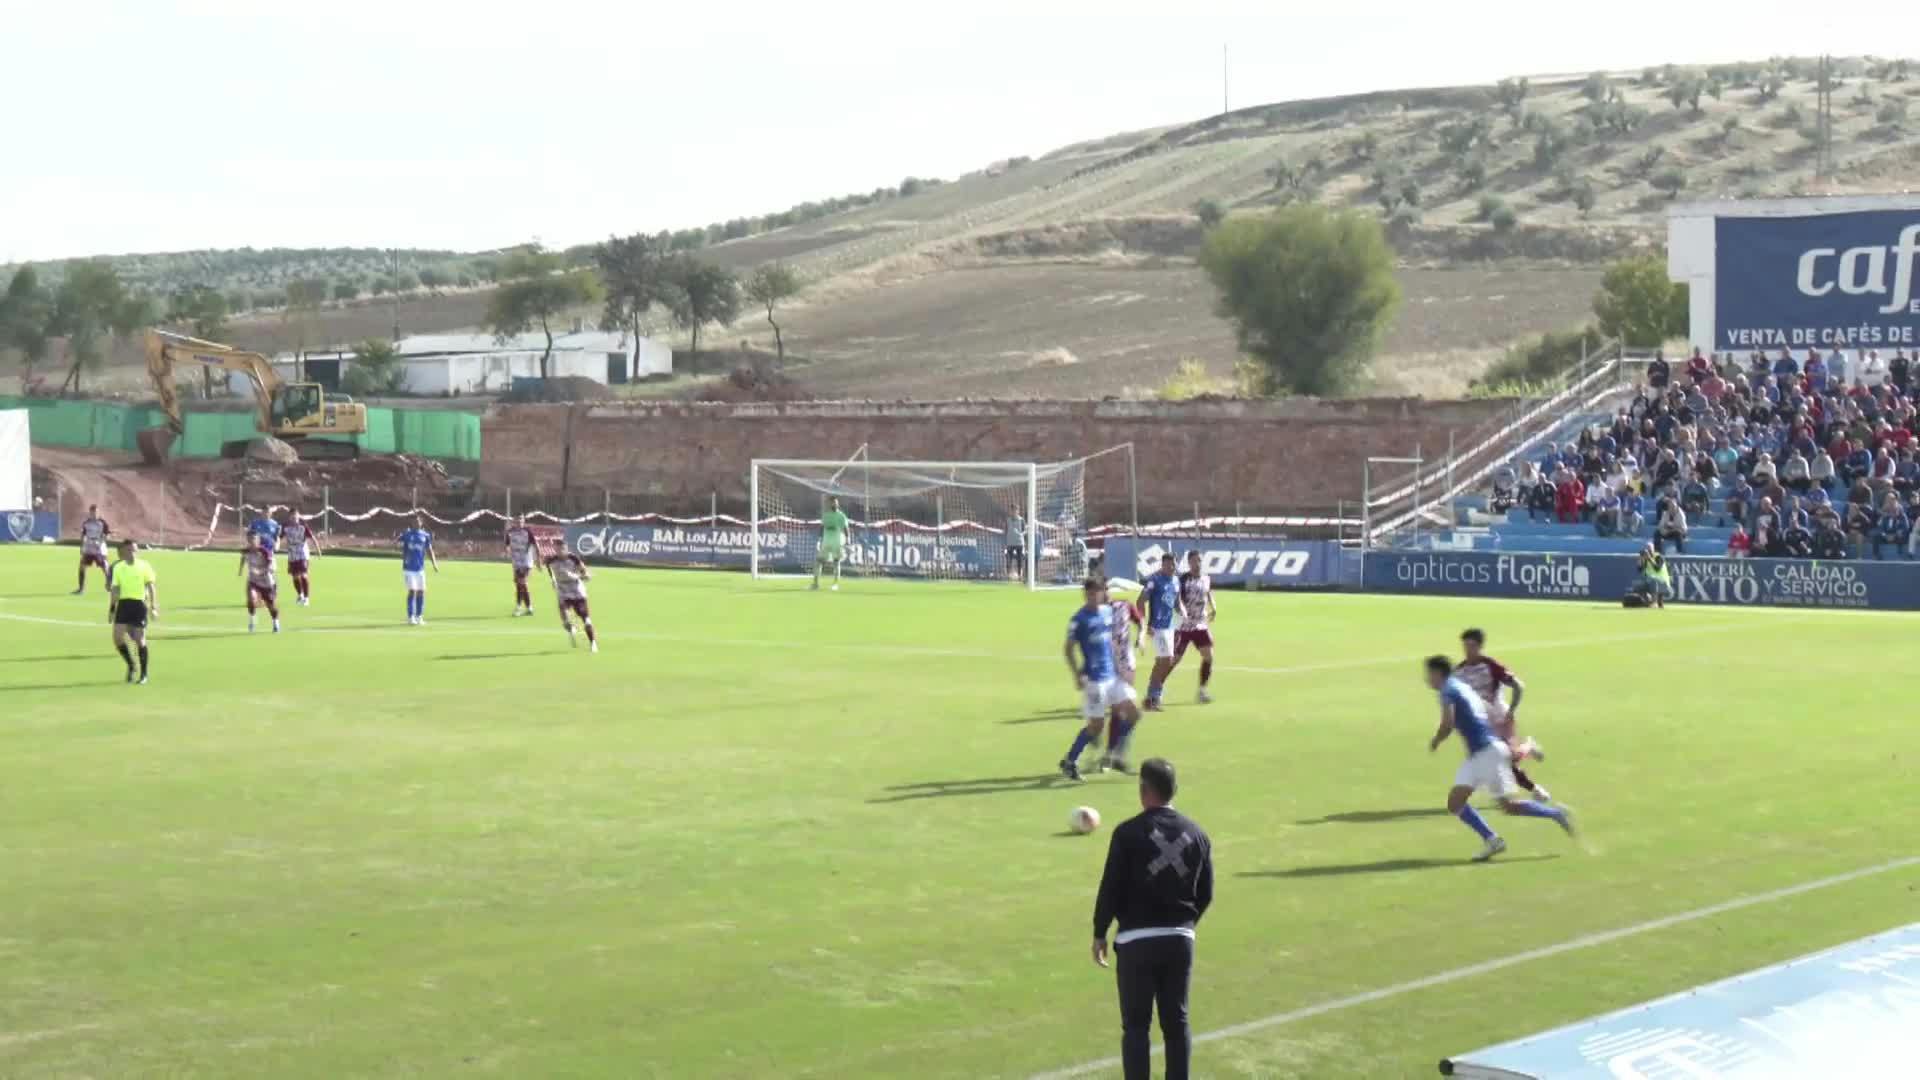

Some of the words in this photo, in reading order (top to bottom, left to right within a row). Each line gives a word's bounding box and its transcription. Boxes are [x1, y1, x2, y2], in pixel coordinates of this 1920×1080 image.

[1727, 328, 1786, 345] VENTA
[1792, 328, 1817, 344] DE
[1822, 322, 1882, 345] CAFÉS
[1888, 326, 1913, 343] DE
[652, 529, 685, 543] BAR
[686, 533, 706, 543] LOS
[1397, 555, 1490, 587] ópticas
[1497, 556, 1590, 586] florida
[1672, 560, 1756, 577] ARNICERÍA
[1774, 564, 1856, 582] CALIDAD
[1528, 585, 1590, 595] LINARES
[1764, 579, 1775, 592] Y
[1782, 579, 1867, 597] SERVICIO
